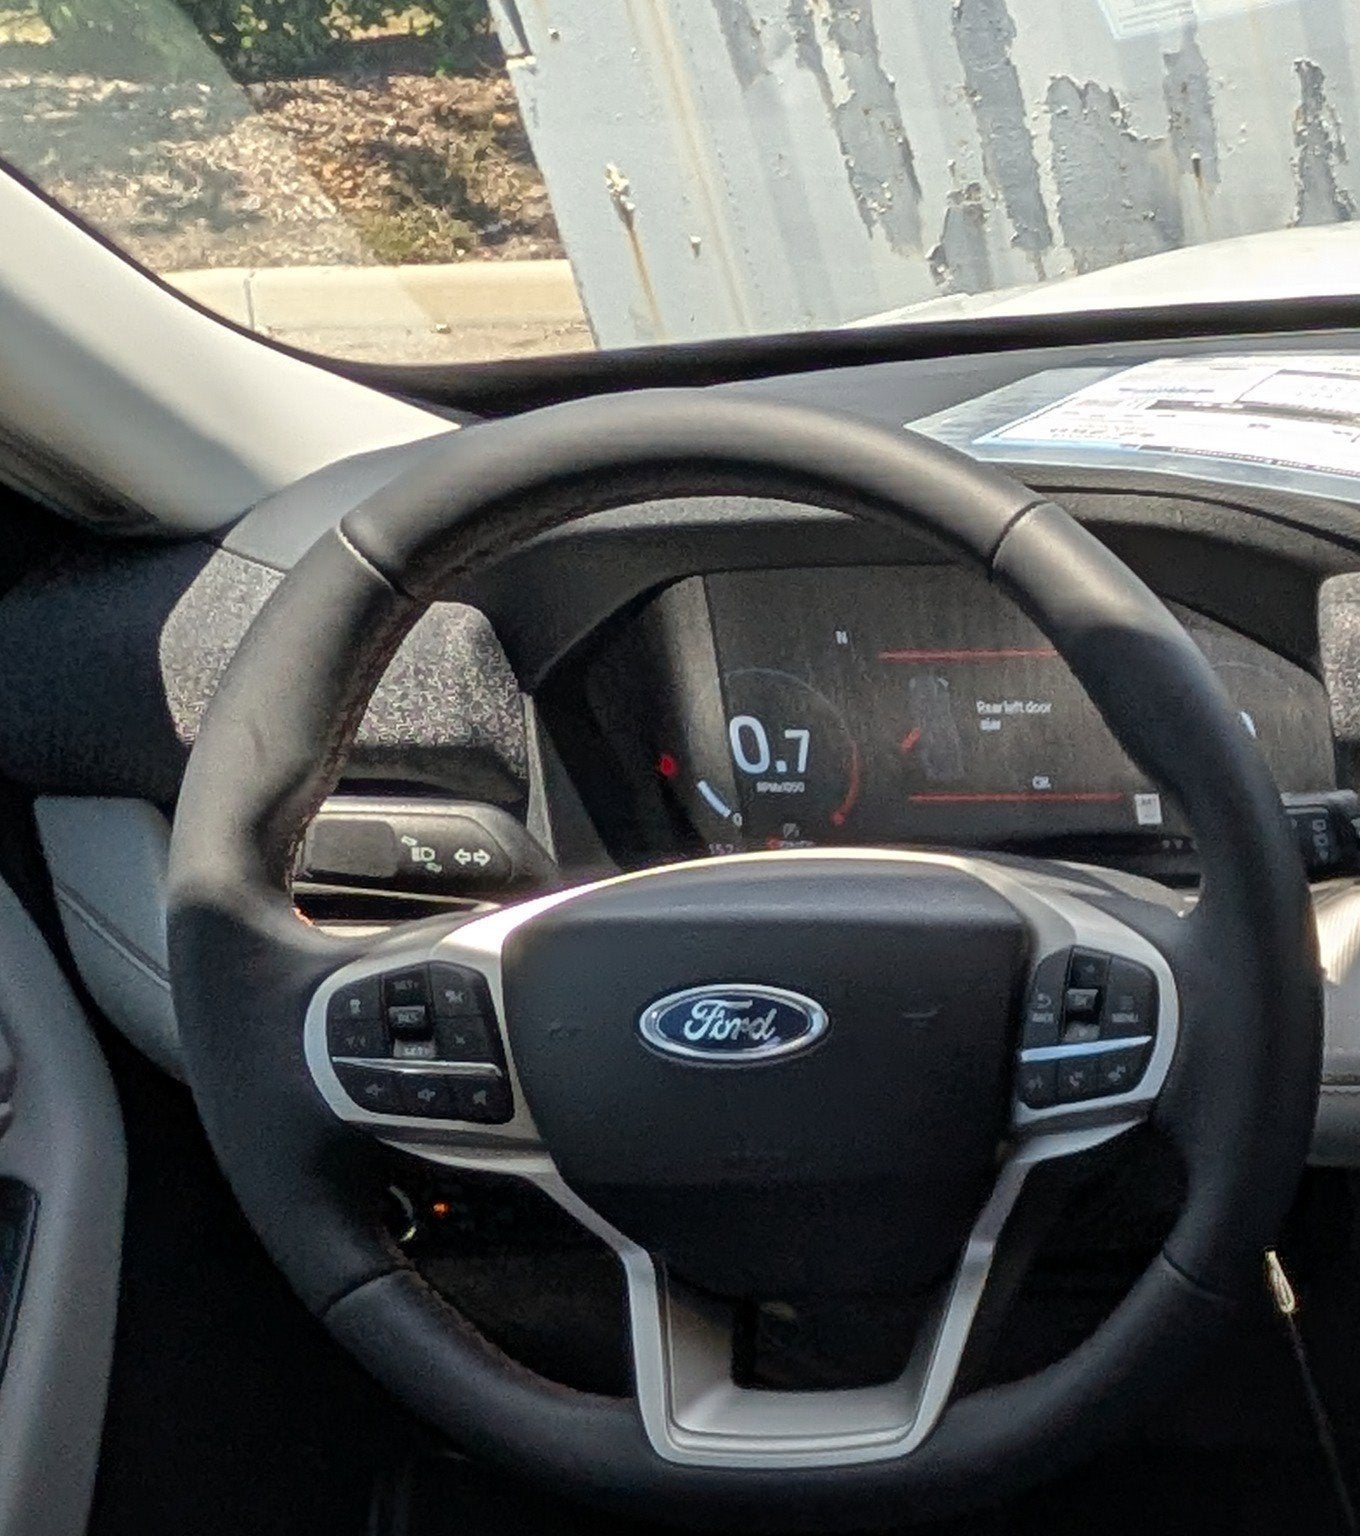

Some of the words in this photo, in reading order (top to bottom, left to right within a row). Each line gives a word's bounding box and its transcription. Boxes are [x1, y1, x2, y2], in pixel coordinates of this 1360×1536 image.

[1025, 700, 1052, 714] door
[728, 714, 811, 775] 0.7
[683, 999, 778, 1042] Ford
